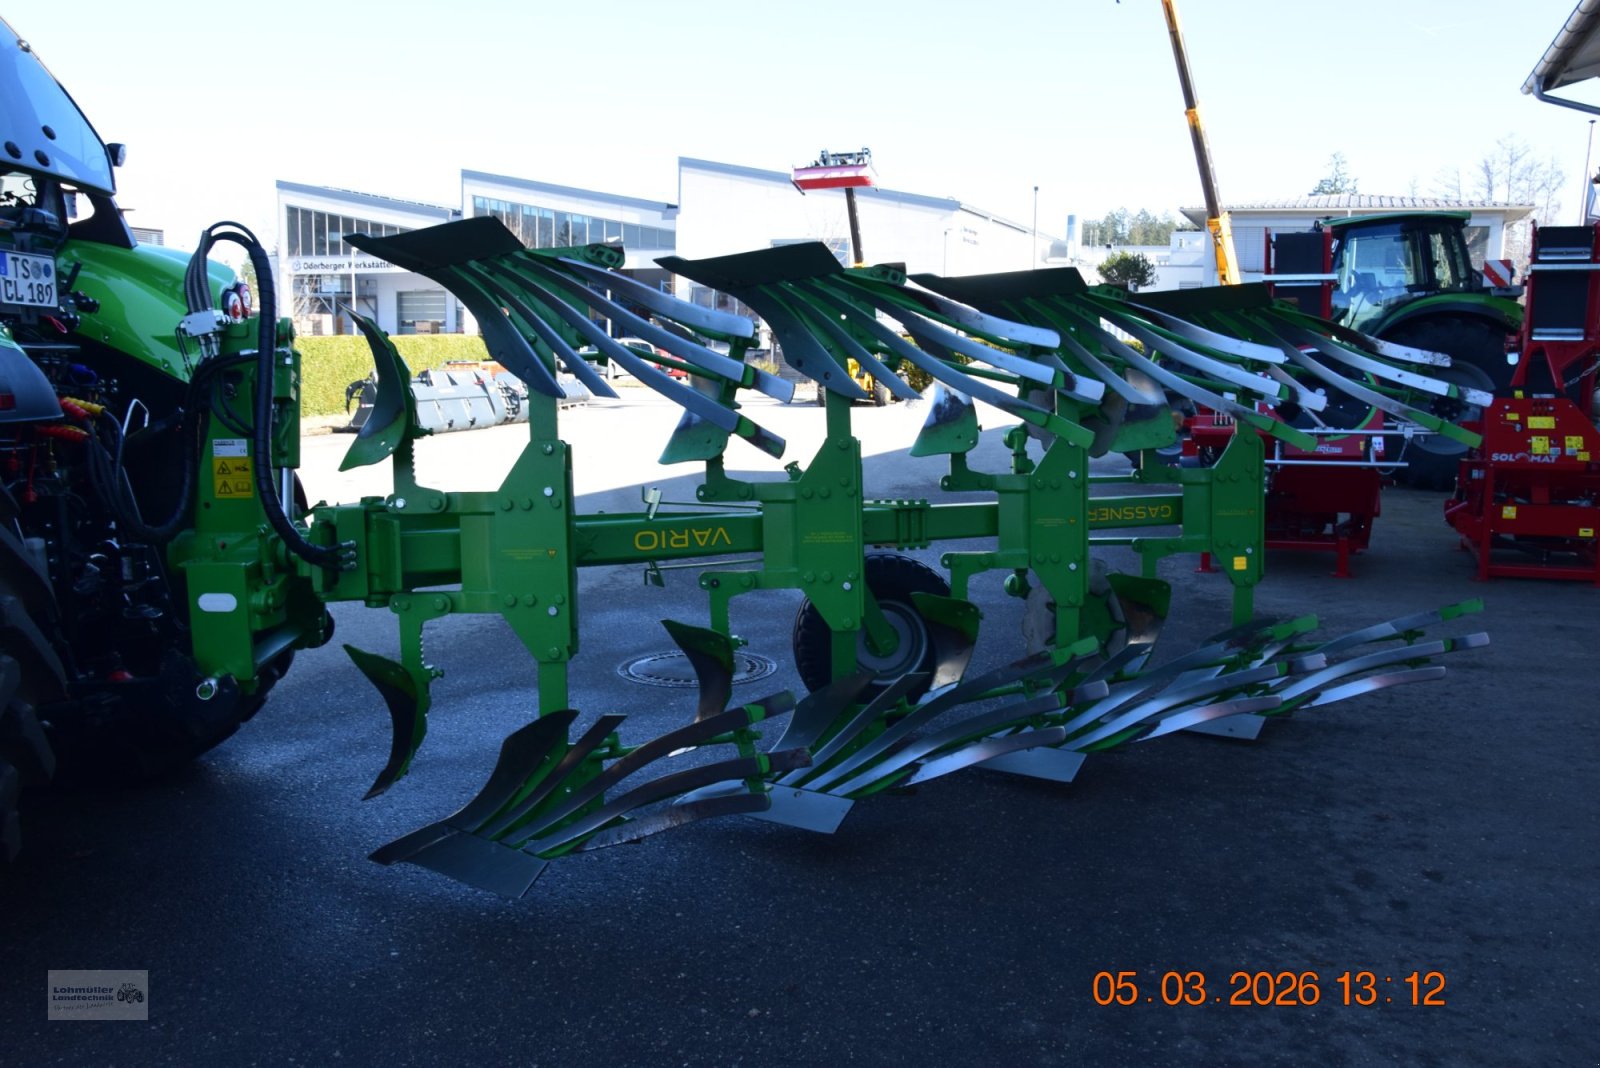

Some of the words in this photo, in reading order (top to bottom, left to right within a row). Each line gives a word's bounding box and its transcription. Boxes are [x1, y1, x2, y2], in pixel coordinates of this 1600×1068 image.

[11, 256, 30, 279] TS
[303, 261, 345, 271] Oderberger
[4, 280, 24, 301] CL
[27, 283, 53, 304] 189
[633, 527, 732, 551] VARIO
